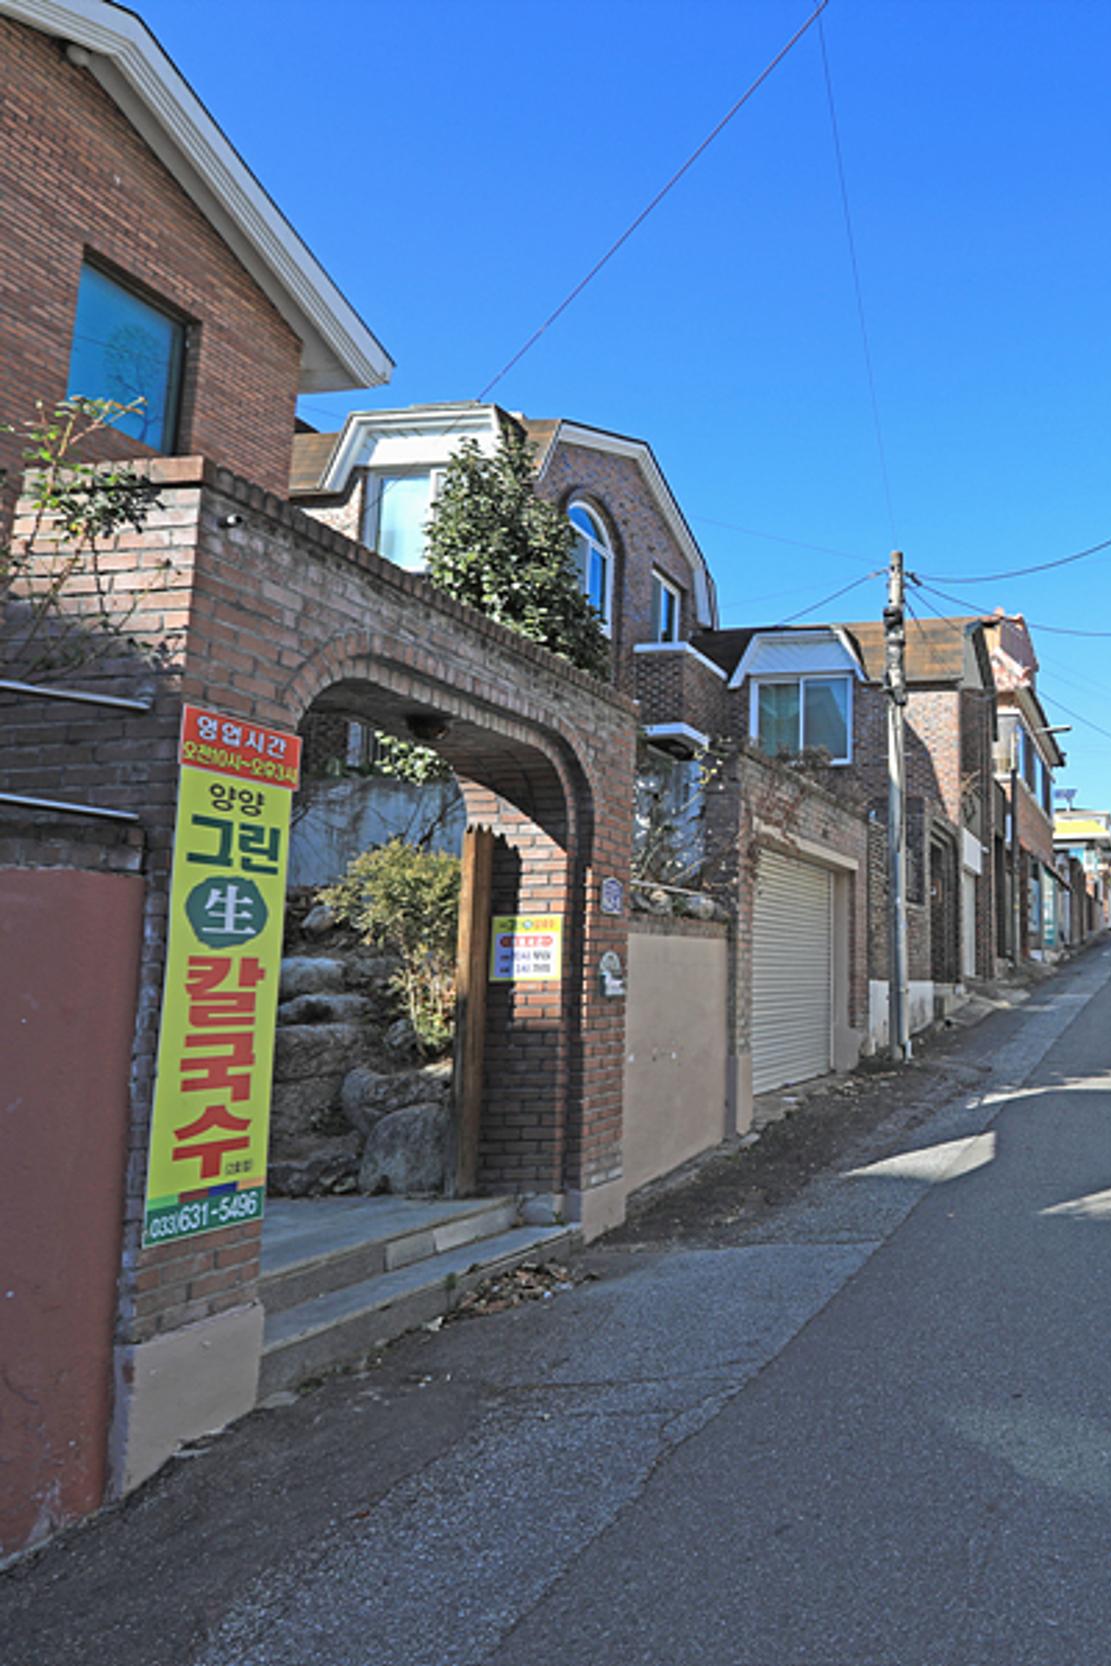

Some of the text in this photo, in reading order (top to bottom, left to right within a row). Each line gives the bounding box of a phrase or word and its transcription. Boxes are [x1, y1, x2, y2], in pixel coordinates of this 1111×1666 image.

[197, 715, 287, 759] 영업시간
[209, 783, 264, 817] 양양
[186, 813, 281, 876] 그린
[202, 883, 256, 934] 生
[172, 955, 266, 1180] 칼국수
